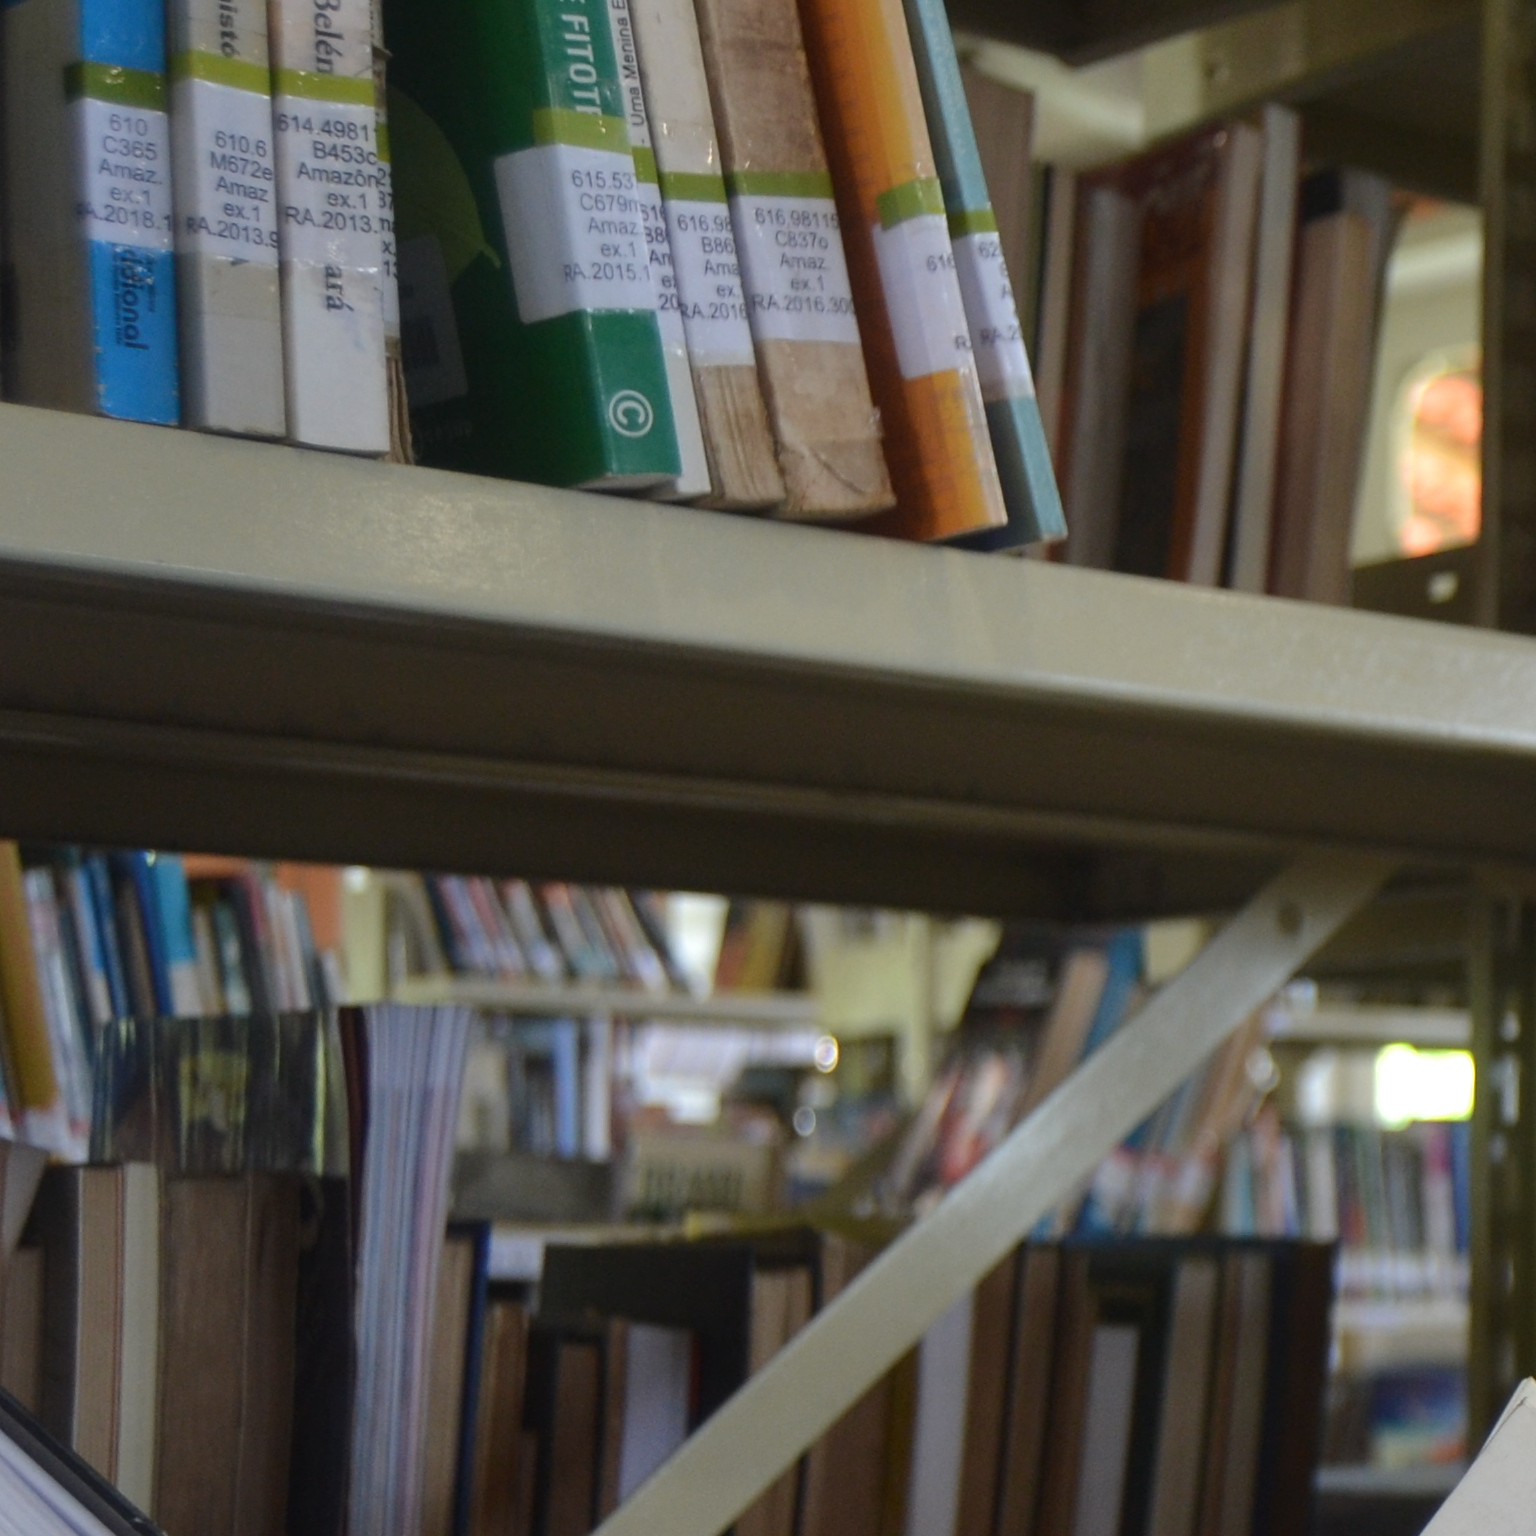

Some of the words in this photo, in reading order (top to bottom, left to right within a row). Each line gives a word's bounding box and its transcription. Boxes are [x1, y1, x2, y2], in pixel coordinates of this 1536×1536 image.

[617, 17, 638, 80] Menina
[630, 86, 644, 126] Uma
[109, 114, 149, 136] 610
[102, 136, 158, 161] C365
[214, 130, 267, 158] 610.6
[209, 151, 274, 181] M672e
[110, 186, 151, 206] ex.1
[327, 192, 367, 210] ex.1
[223, 202, 261, 222] ex.1
[601, 242, 637, 257] ex.1
[325, 264, 354, 312] ará
